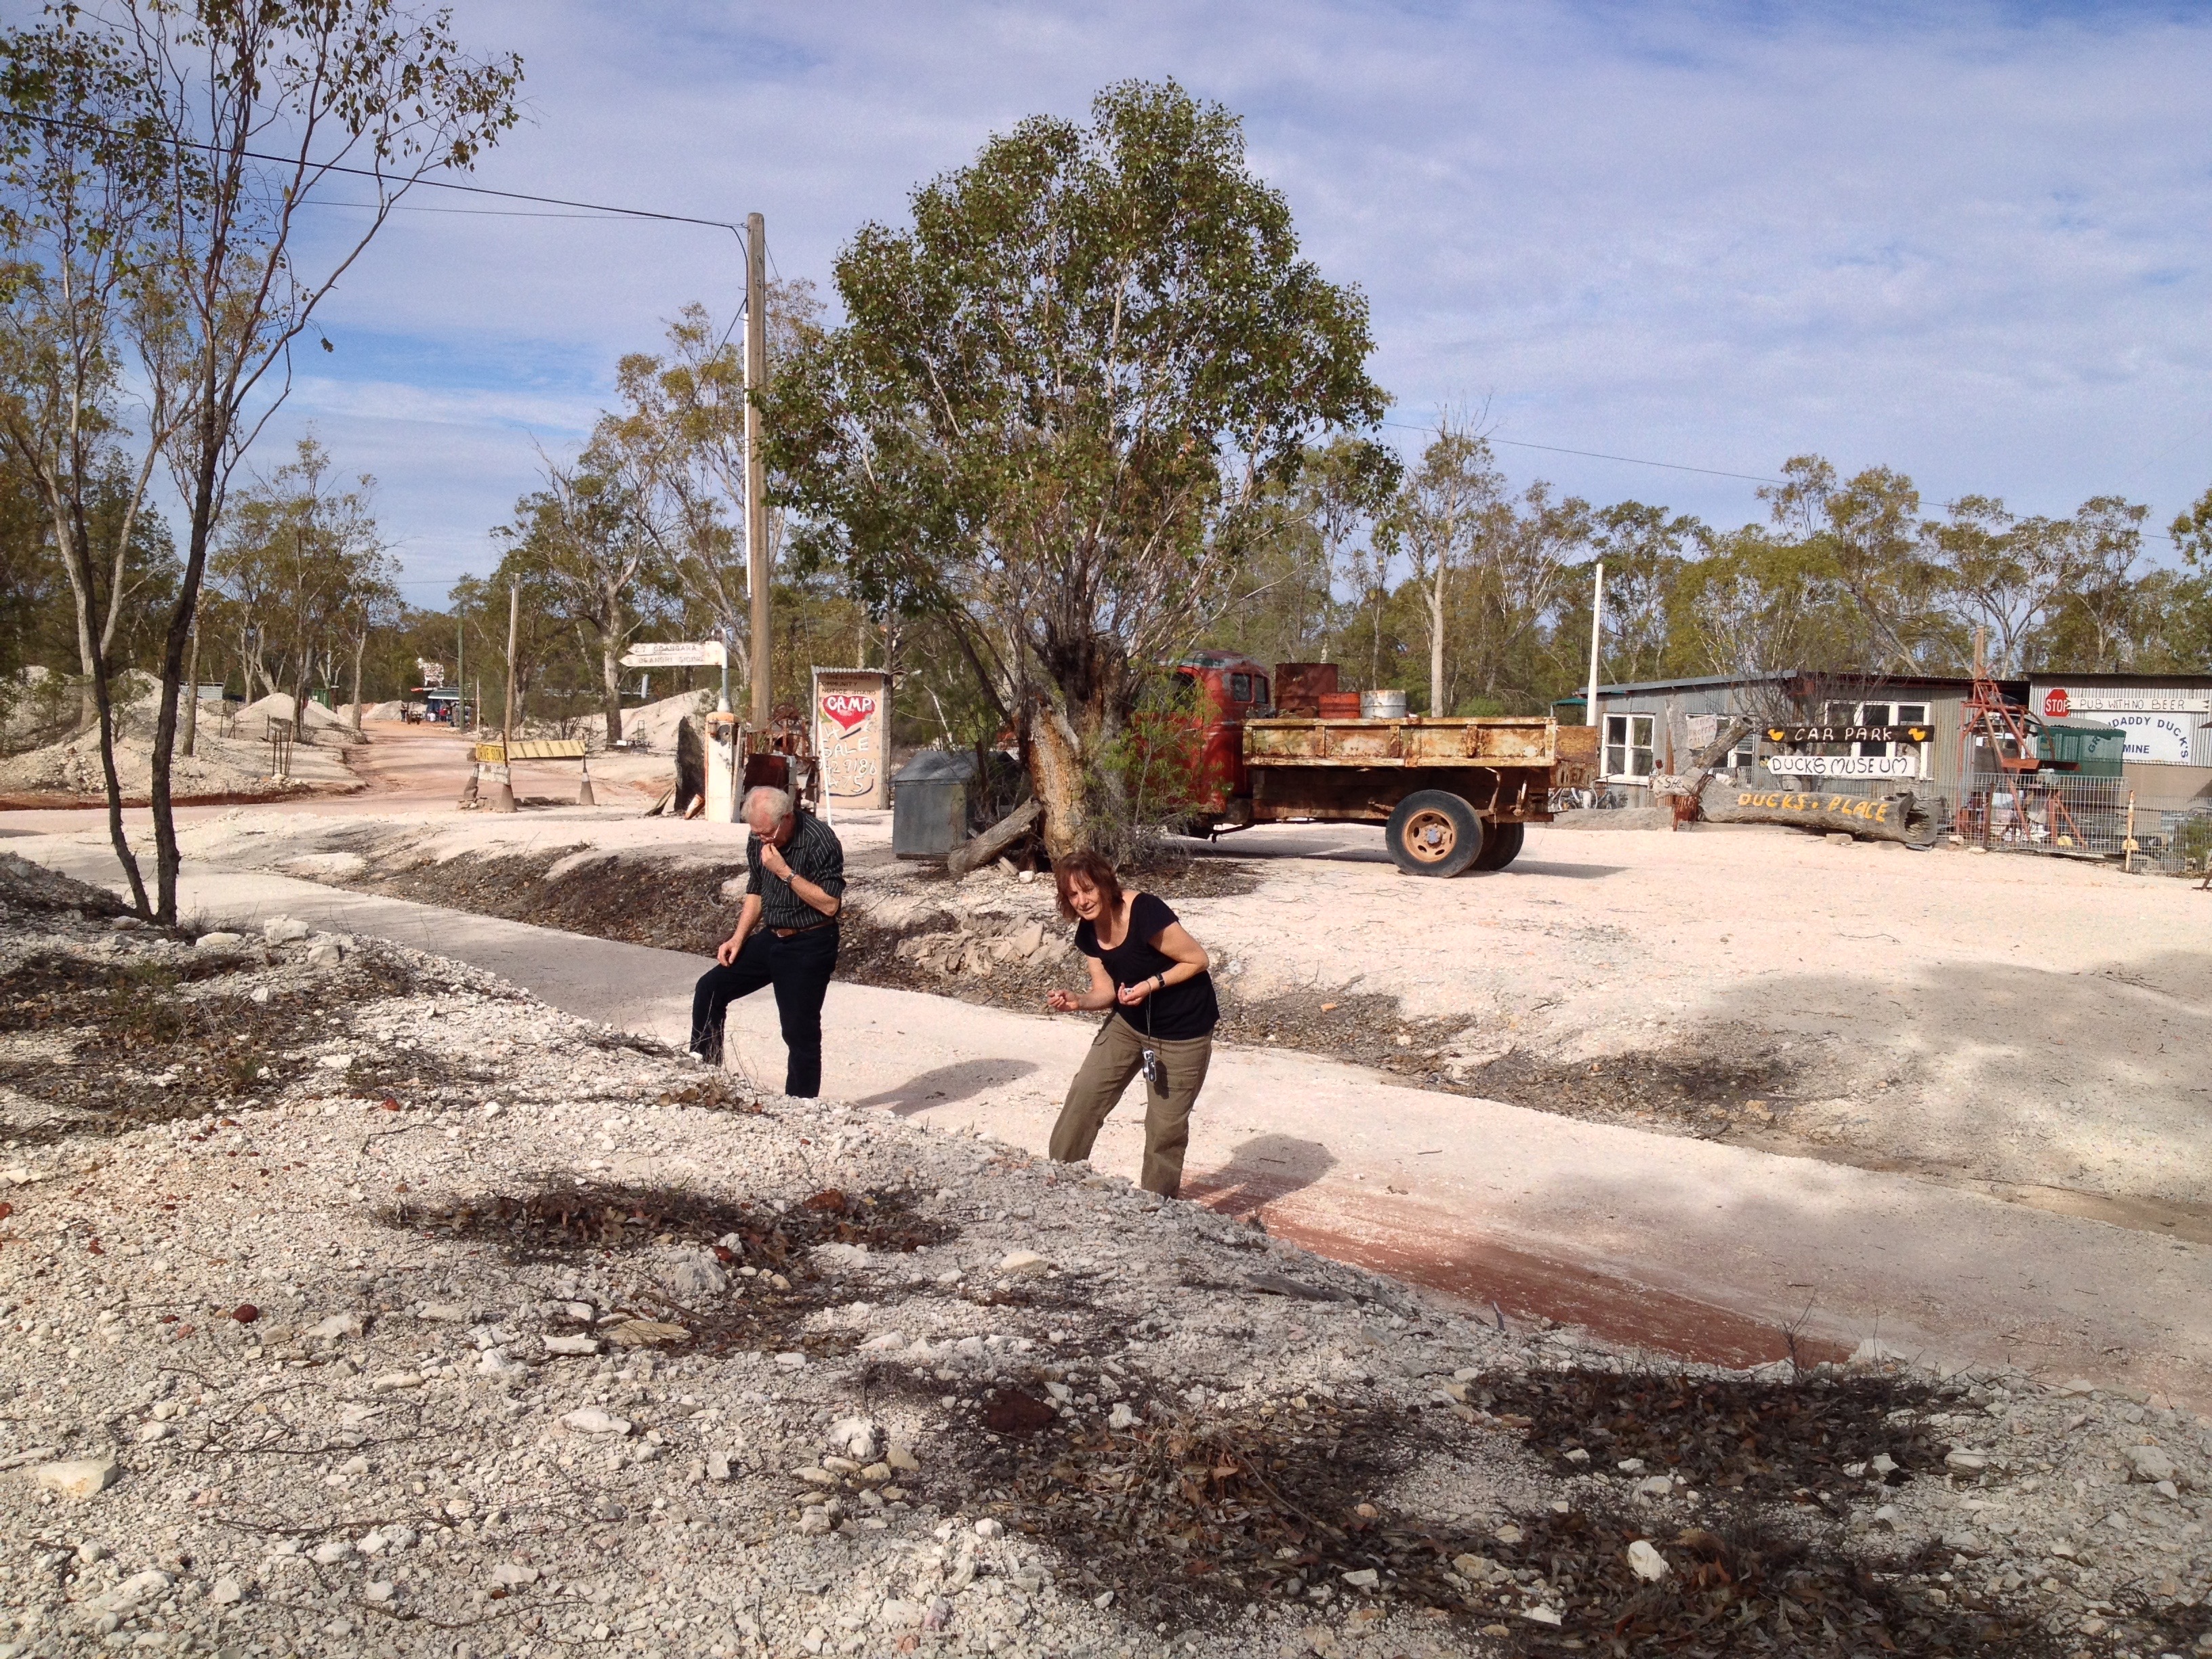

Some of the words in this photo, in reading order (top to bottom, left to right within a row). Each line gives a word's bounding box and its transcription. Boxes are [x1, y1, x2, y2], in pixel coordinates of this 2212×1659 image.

[827, 696, 872, 713] CAMP
[2045, 699, 2068, 712] STOP
[2080, 699, 2104, 709] PUB
[2152, 699, 2185, 710] BEER
[1795, 728, 1834, 741] CAR
[1845, 726, 1893, 741] PARK
[2157, 719, 2189, 758] DUCK'S
[2123, 744, 2150, 754] MINE
[1772, 757, 1826, 774] DUCK'S
[1828, 796, 1889, 822] PLACE
